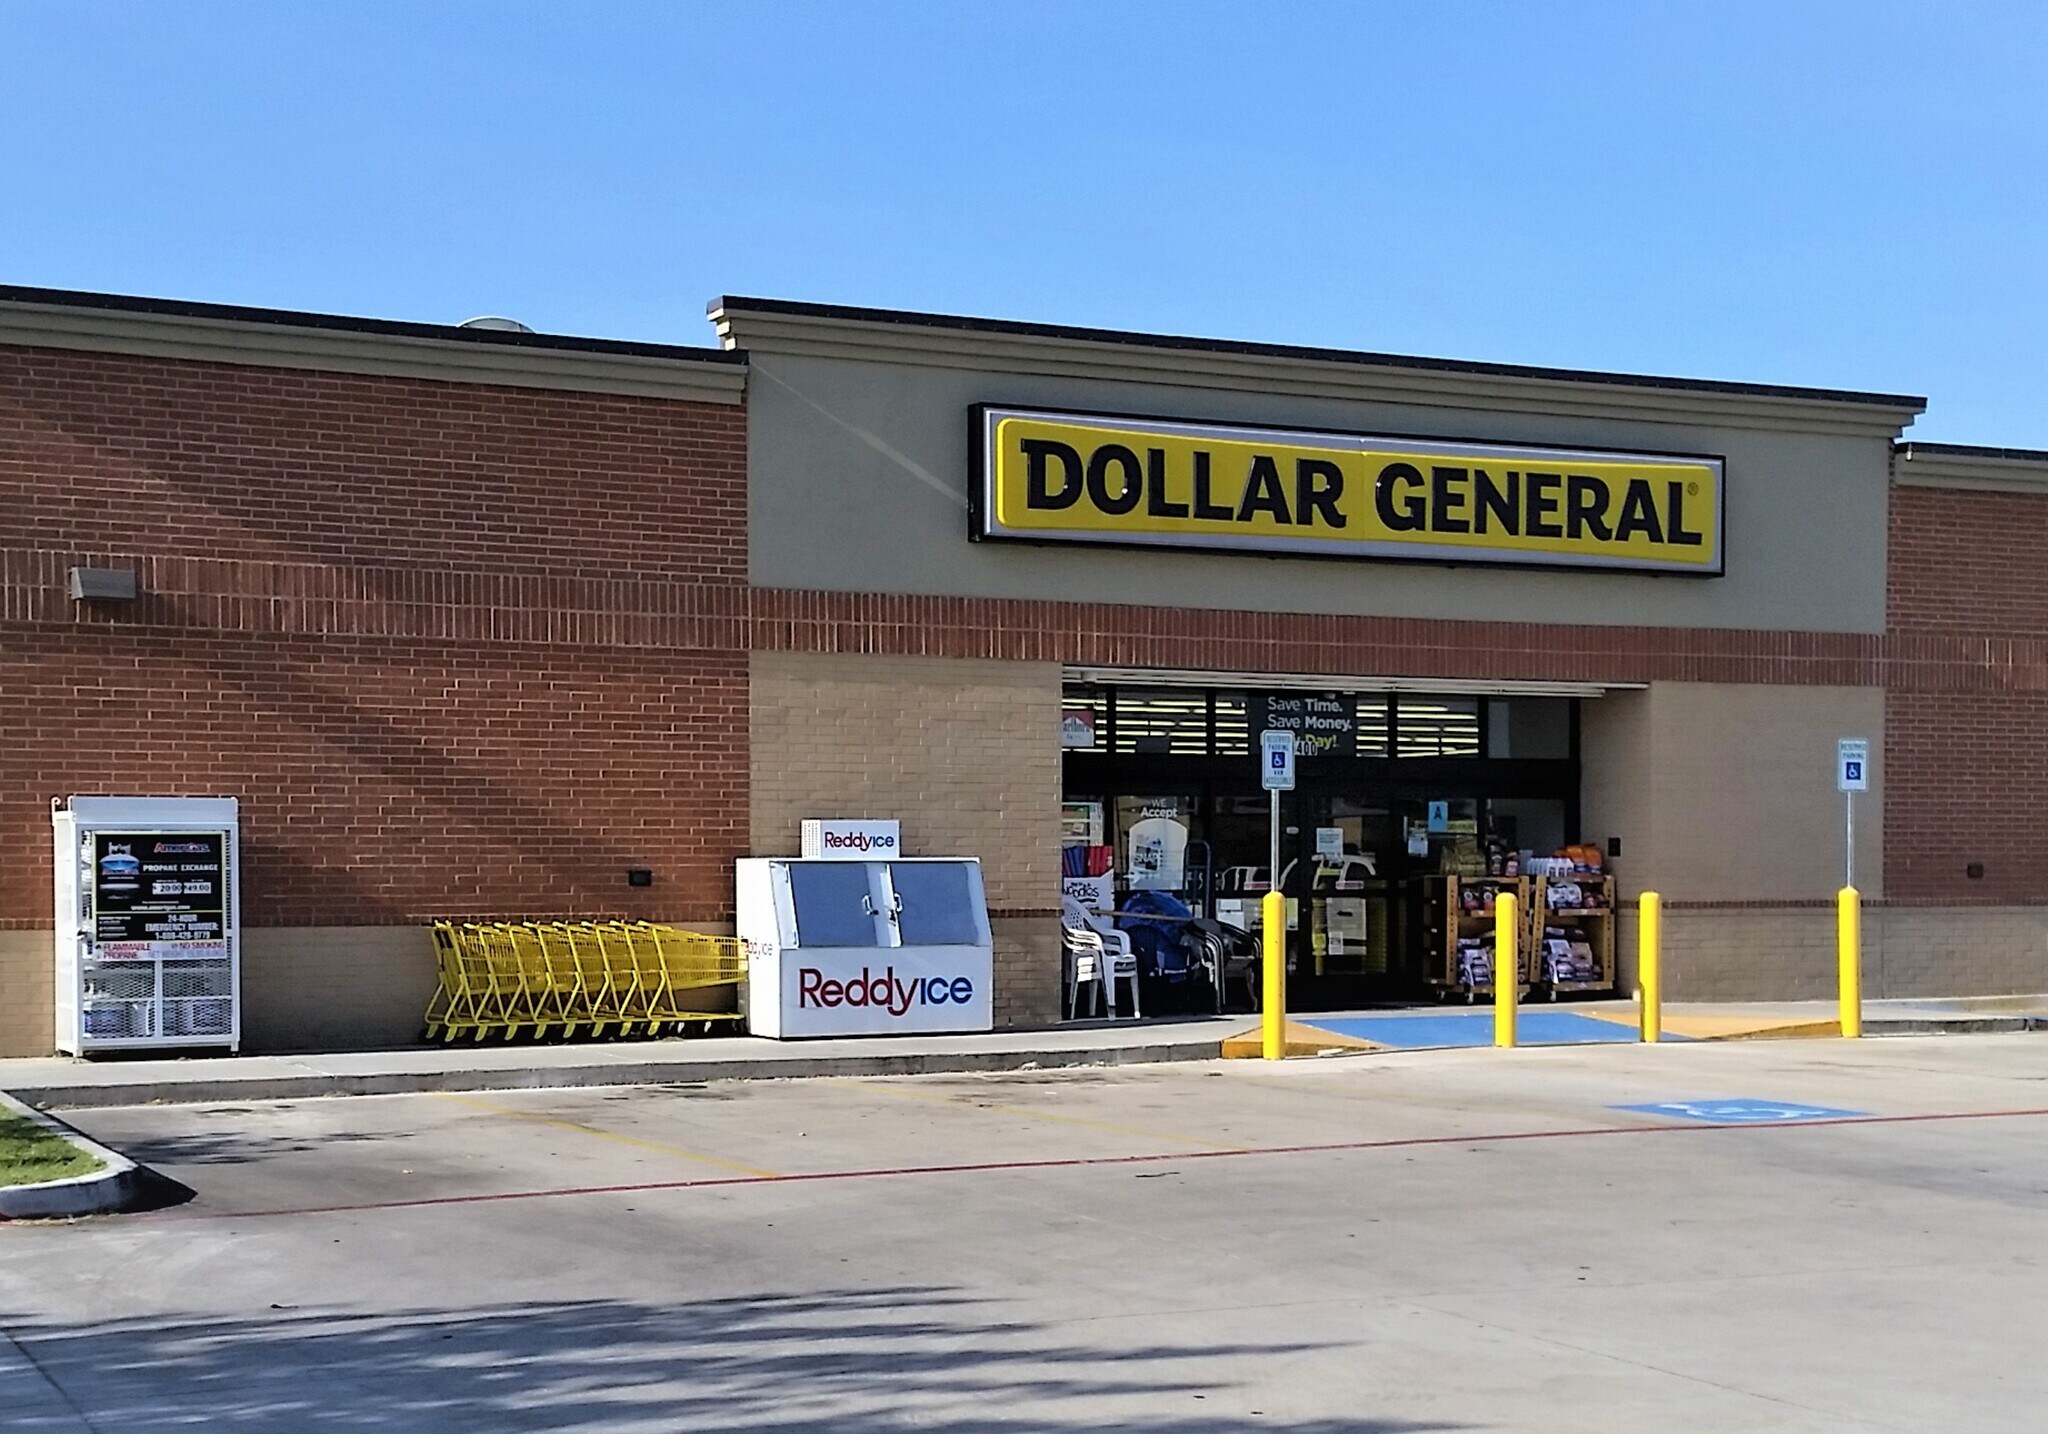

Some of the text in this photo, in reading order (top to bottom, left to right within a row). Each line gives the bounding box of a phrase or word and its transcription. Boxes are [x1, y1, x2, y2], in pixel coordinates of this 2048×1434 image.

[1020, 438, 1703, 546] DOLLAR GENERAL
[1267, 696, 1343, 712] Save Time.
[1267, 714, 1353, 732] Save Money.
[1304, 734, 1337, 751] Day!
[1151, 799, 1167, 807] WE
[1141, 807, 1178, 818] Accept
[143, 864, 178, 872] PROPANE
[103, 943, 151, 951] FLAMMABLE
[103, 951, 138, 959] PROPANE
